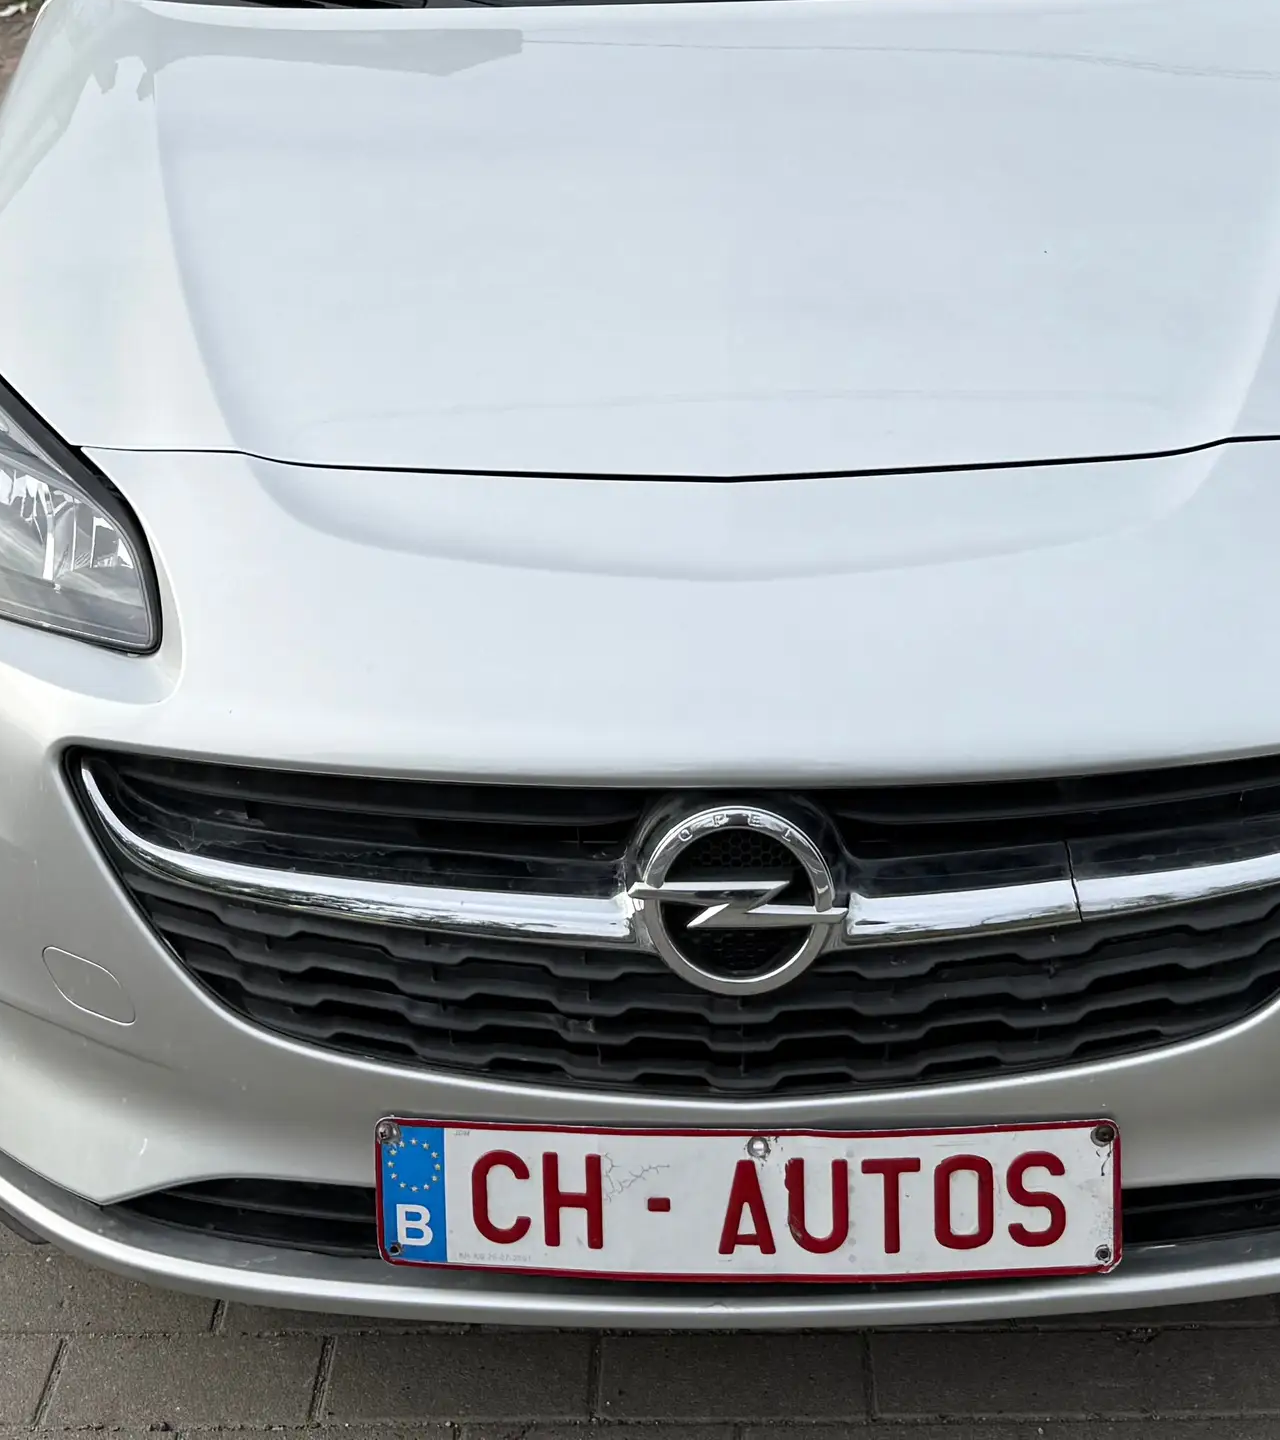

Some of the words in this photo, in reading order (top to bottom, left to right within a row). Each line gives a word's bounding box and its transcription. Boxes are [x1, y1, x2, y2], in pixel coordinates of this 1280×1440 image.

[677, 813, 792, 842] OPEL
[396, 1203, 433, 1246] B
[472, 1151, 603, 1250] CH
[719, 1152, 1067, 1255] AUTOS
